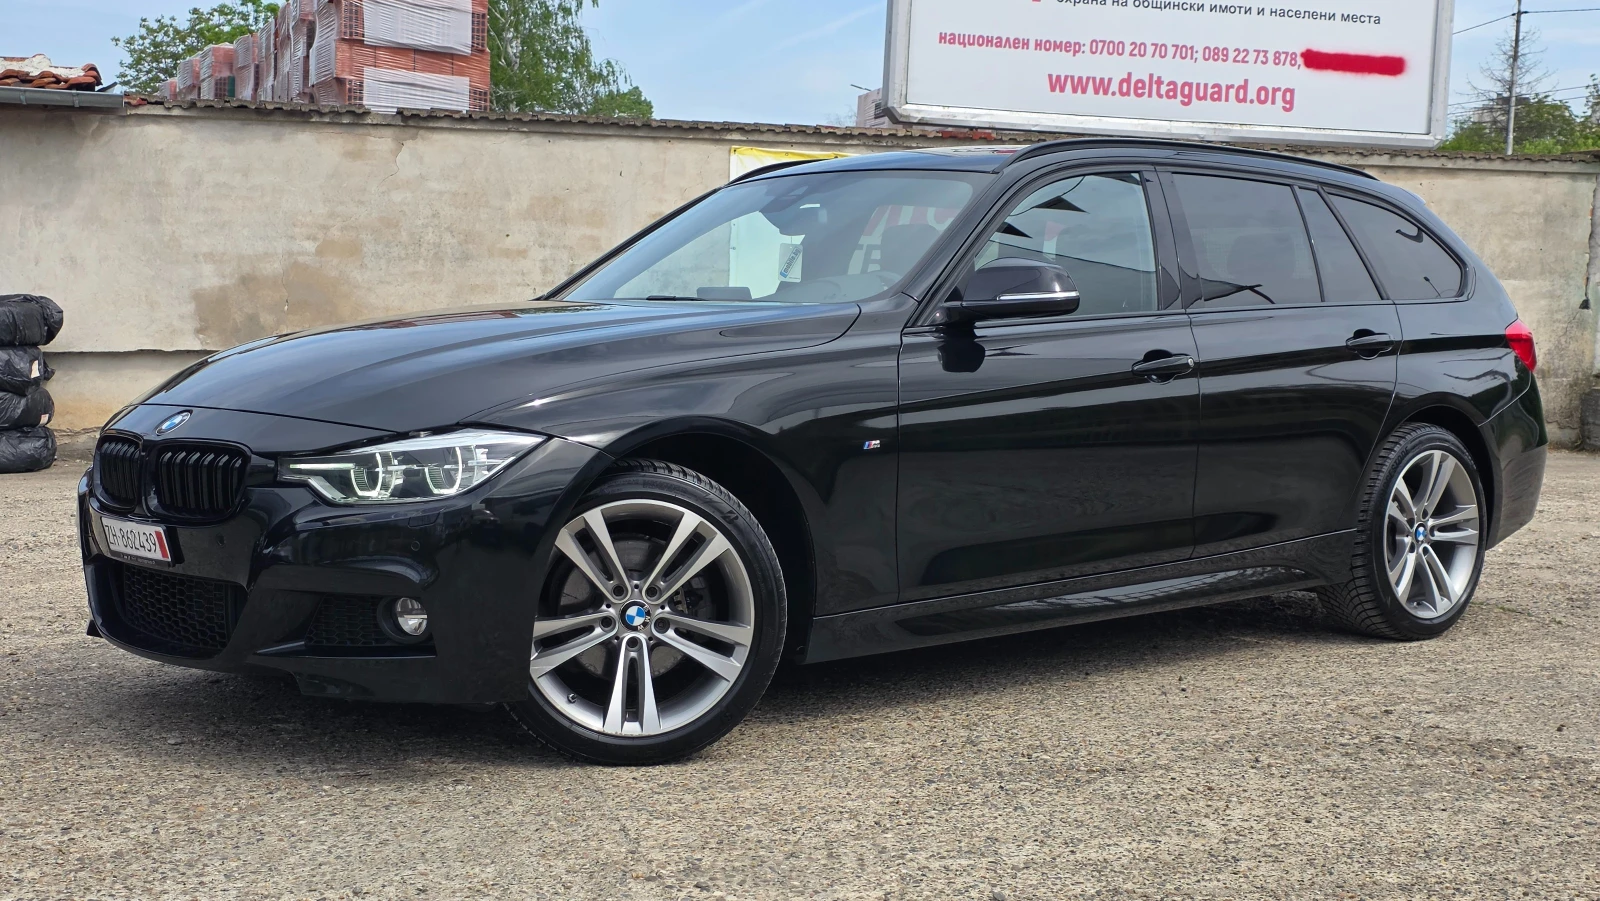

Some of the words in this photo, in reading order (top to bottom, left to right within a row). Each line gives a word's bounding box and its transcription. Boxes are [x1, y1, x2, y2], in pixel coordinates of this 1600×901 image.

[1111, 0, 1128, 8] на
[1132, 0, 1205, 12] общински
[1209, 3, 1252, 16] имоти
[1256, 6, 1265, 16] и
[1269, 7, 1336, 22] населени
[1340, 13, 1381, 25] места
[937, 31, 1030, 52] национален
[1033, 38, 1086, 57] номер:
[1089, 39, 1125, 58] 0700
[1128, 41, 1147, 58] 20
[1151, 42, 1168, 60] 70
[1171, 44, 1199, 63] 701;
[1202, 46, 1229, 63] 089
[1232, 48, 1249, 64] 22
[1253, 49, 1269, 66] 73
[1047, 71, 1296, 112] www.deltaguard.org
